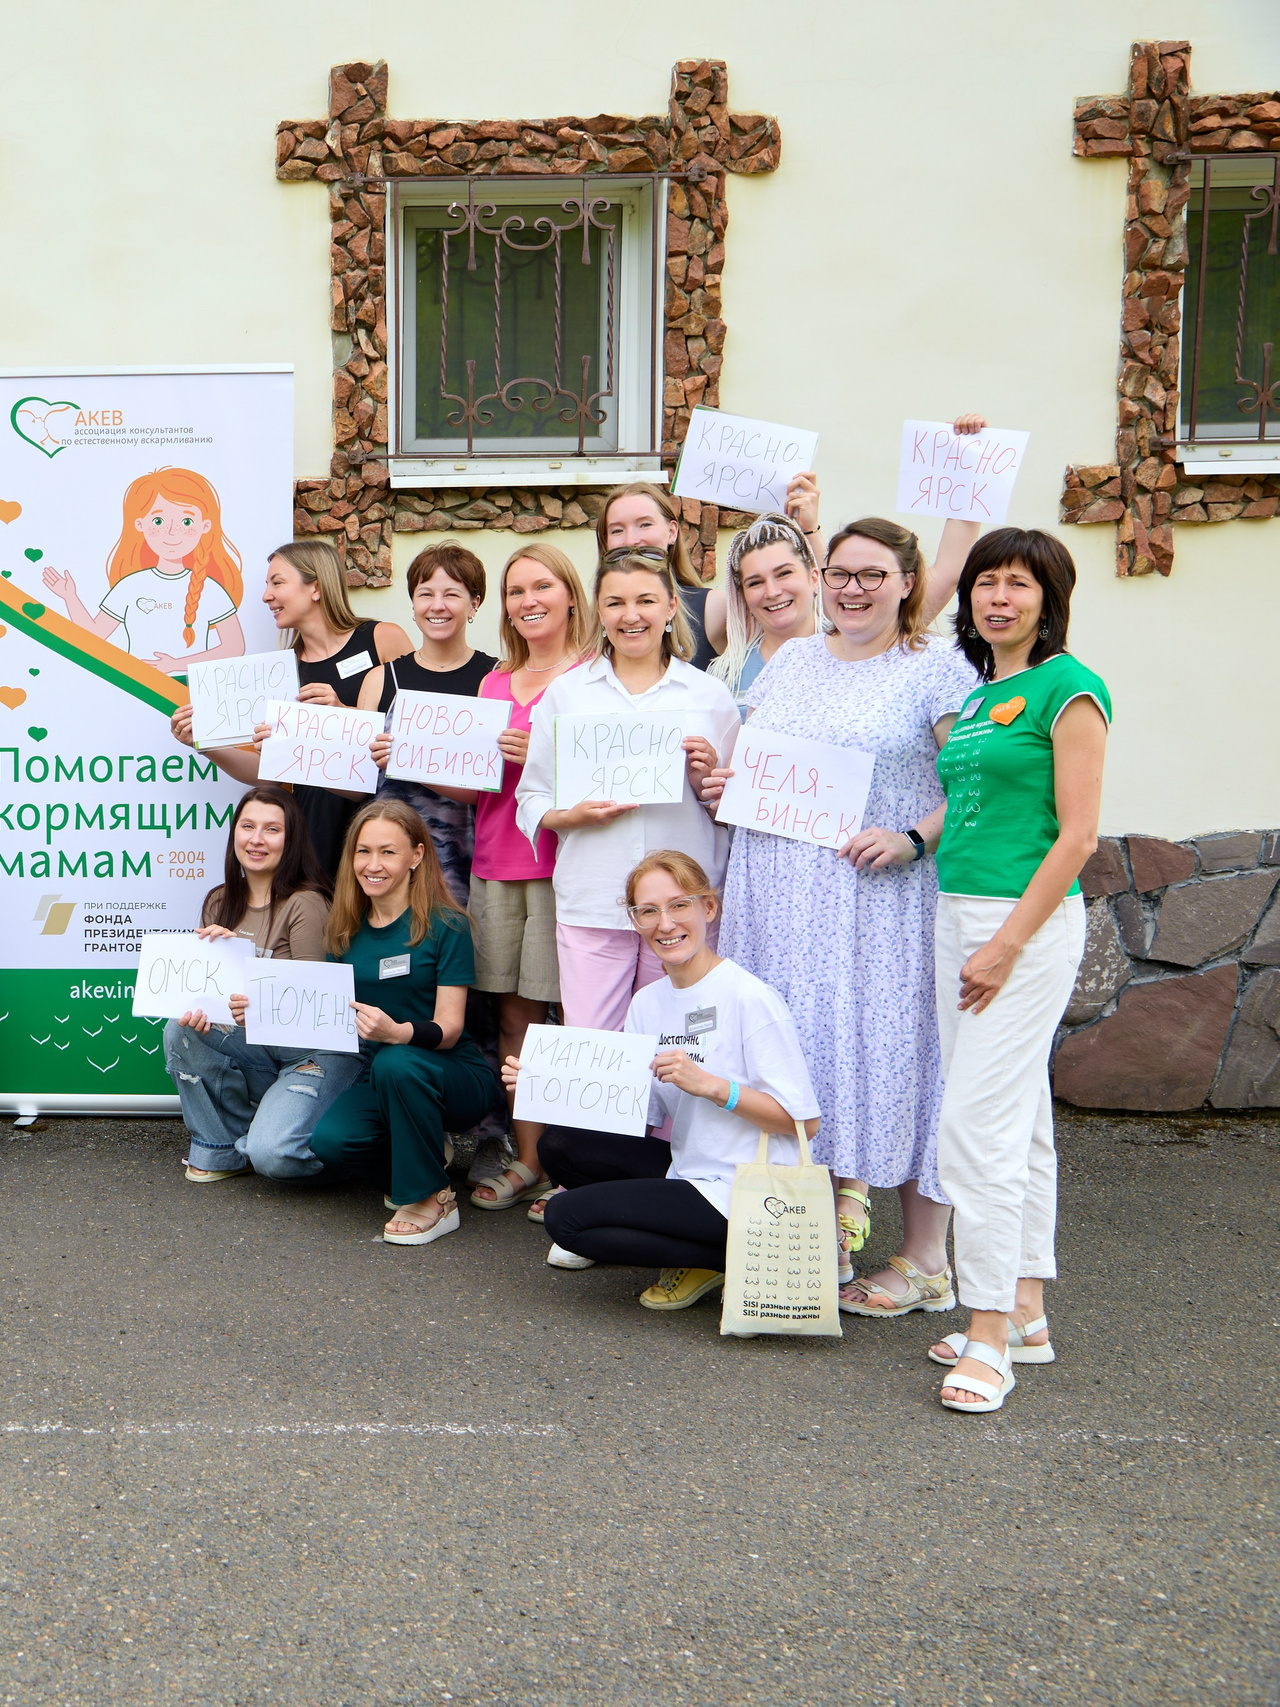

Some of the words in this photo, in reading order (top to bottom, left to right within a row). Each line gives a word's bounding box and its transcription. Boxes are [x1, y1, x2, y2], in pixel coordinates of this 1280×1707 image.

[73, 427, 127, 437] ассоциация
[129, 426, 194, 437] консультантов
[74, 409, 124, 427] АКЕВ
[61, 438, 72, 446] по
[73, 437, 139, 447] естественному
[140, 436, 214, 446] вскармливанию
[697, 420, 804, 464] КРАСНО-
[912, 429, 1017, 475] КРАСНО-
[695, 461, 780, 507] ЯРСК
[910, 475, 991, 517] ЯРСК
[153, 602, 173, 610] АКЕВ
[195, 660, 290, 704] КРАСНО-
[205, 691, 288, 737] ЯРС
[395, 741, 499, 779] СИБИРСК
[572, 722, 683, 764] КРАСНО
[274, 744, 365, 784] ЯРСК
[581, 764, 673, 802] ЯРСК
[743, 745, 834, 795] ЧЕЛЯ-
[756, 796, 857, 845] БИНСК
[156, 853, 165, 865] с
[168, 850, 206, 865] 2004
[168, 867, 206, 880] года
[83, 902, 104, 910] ПРИ
[105, 902, 167, 911] ПОДДЕРЖКЕ
[83, 914, 133, 926] ФОНДА
[83, 942, 142, 953] ГРАНТОВ
[148, 957, 224, 996] ОМСК
[250, 974, 356, 1035] ТЮМЕНЬ
[529, 1036, 632, 1072] МАГНИ-
[525, 1075, 648, 1120] ТОГОРСК
[782, 1205, 807, 1215] АКЕВ
[742, 1299, 759, 1308] SISI
[760, 1302, 791, 1311] разные
[792, 1304, 821, 1313] нужны
[742, 1308, 758, 1317] SISI
[759, 1311, 791, 1320] разные
